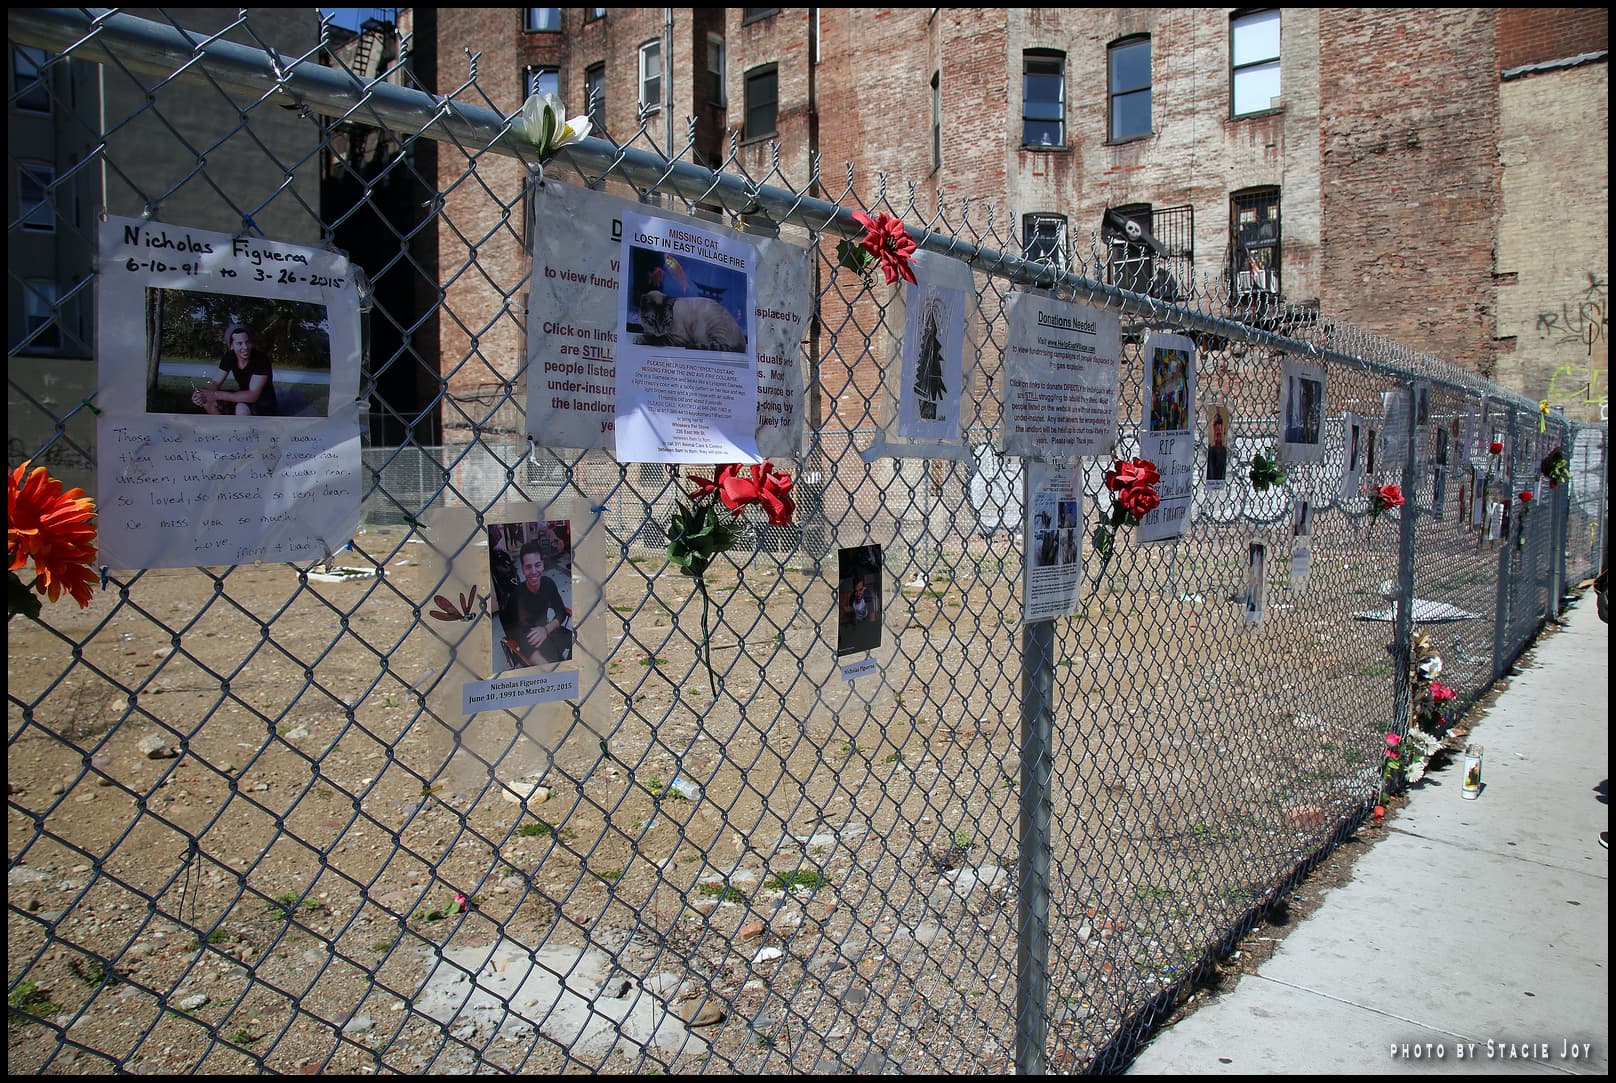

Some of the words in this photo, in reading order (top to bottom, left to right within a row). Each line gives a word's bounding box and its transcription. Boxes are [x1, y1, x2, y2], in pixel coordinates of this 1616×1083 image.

[124, 225, 213, 253] Nicholas
[232, 238, 308, 266] Figueroa
[669, 229, 703, 245] MISSING
[704, 237, 719, 250] CAT
[634, 232, 660, 246] LOST
[662, 238, 671, 248] IN
[673, 240, 696, 254] EAST
[697, 246, 728, 263] VILLAGE
[729, 256, 745, 268] FIRE
[220, 267, 237, 278] to
[545, 266, 556, 279] to
[560, 269, 587, 283] view
[590, 273, 620, 290] fundr
[791, 312, 802, 325] by
[1038, 311, 1072, 328] Donations
[543, 322, 574, 337] Click
[577, 328, 591, 339] on
[594, 328, 617, 343] links
[560, 345, 579, 355] are
[582, 345, 614, 361] STILL
[757, 353, 784, 365] iduals
[544, 361, 584, 376] people
[587, 363, 616, 378] listed
[785, 389, 794, 397] or
[552, 397, 570, 409] the
[783, 402, 794, 414] by
[600, 421, 615, 433] ye
[759, 415, 779, 428] likely
[780, 416, 791, 426] for
[1158, 439, 1175, 455] RIP
[165, 450, 201, 462] walk
[183, 467, 237, 482] unheard
[250, 467, 273, 480] but
[150, 489, 191, 506] loved,
[194, 491, 210, 503] so
[217, 487, 262, 501] missed
[160, 518, 190, 529] miss
[490, 681, 519, 691] Nicholas
[519, 677, 548, 688] Figueroa
[468, 694, 486, 705] June
[500, 691, 517, 700] 1991
[517, 690, 525, 698] to
[525, 686, 546, 697] March
[546, 685, 557, 695] 27,
[557, 682, 573, 692] 2015
